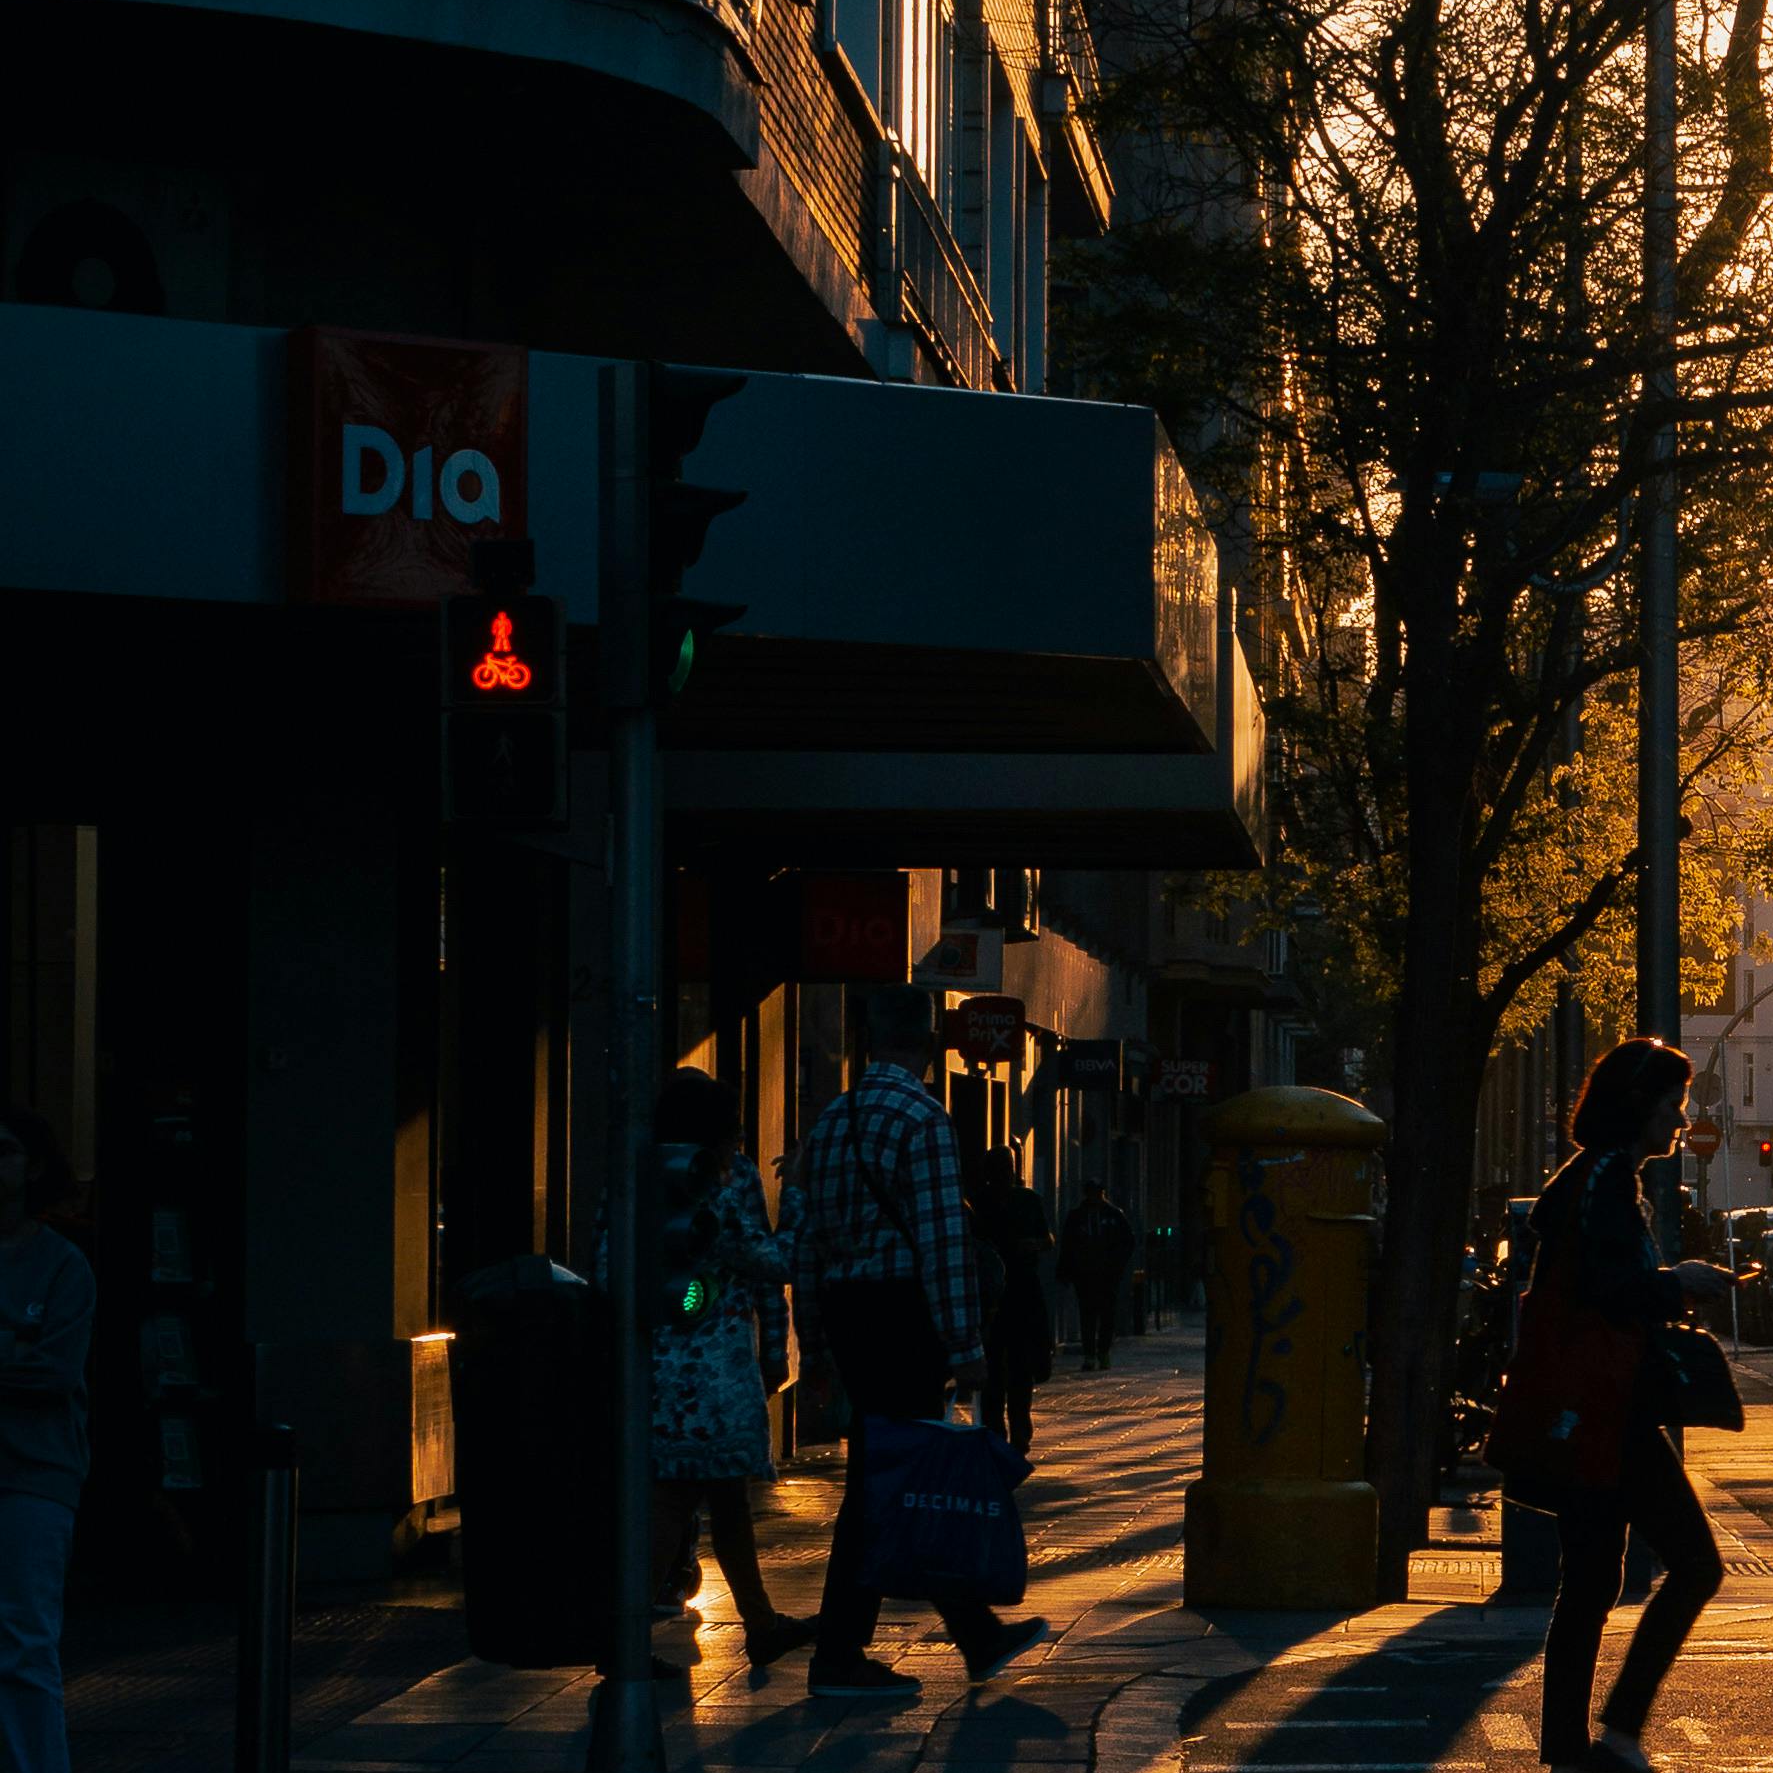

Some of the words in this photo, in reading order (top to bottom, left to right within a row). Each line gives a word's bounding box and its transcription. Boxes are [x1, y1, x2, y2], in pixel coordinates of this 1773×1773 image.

[342, 423, 501, 525] Dia
[967, 1011, 1017, 1026] Prima
[1074, 1058, 1117, 1072] BBVA
[1160, 1059, 1210, 1075] SUPER
[1160, 1075, 1209, 1095] COR
[903, 1492, 1001, 1517] DECIMAS
